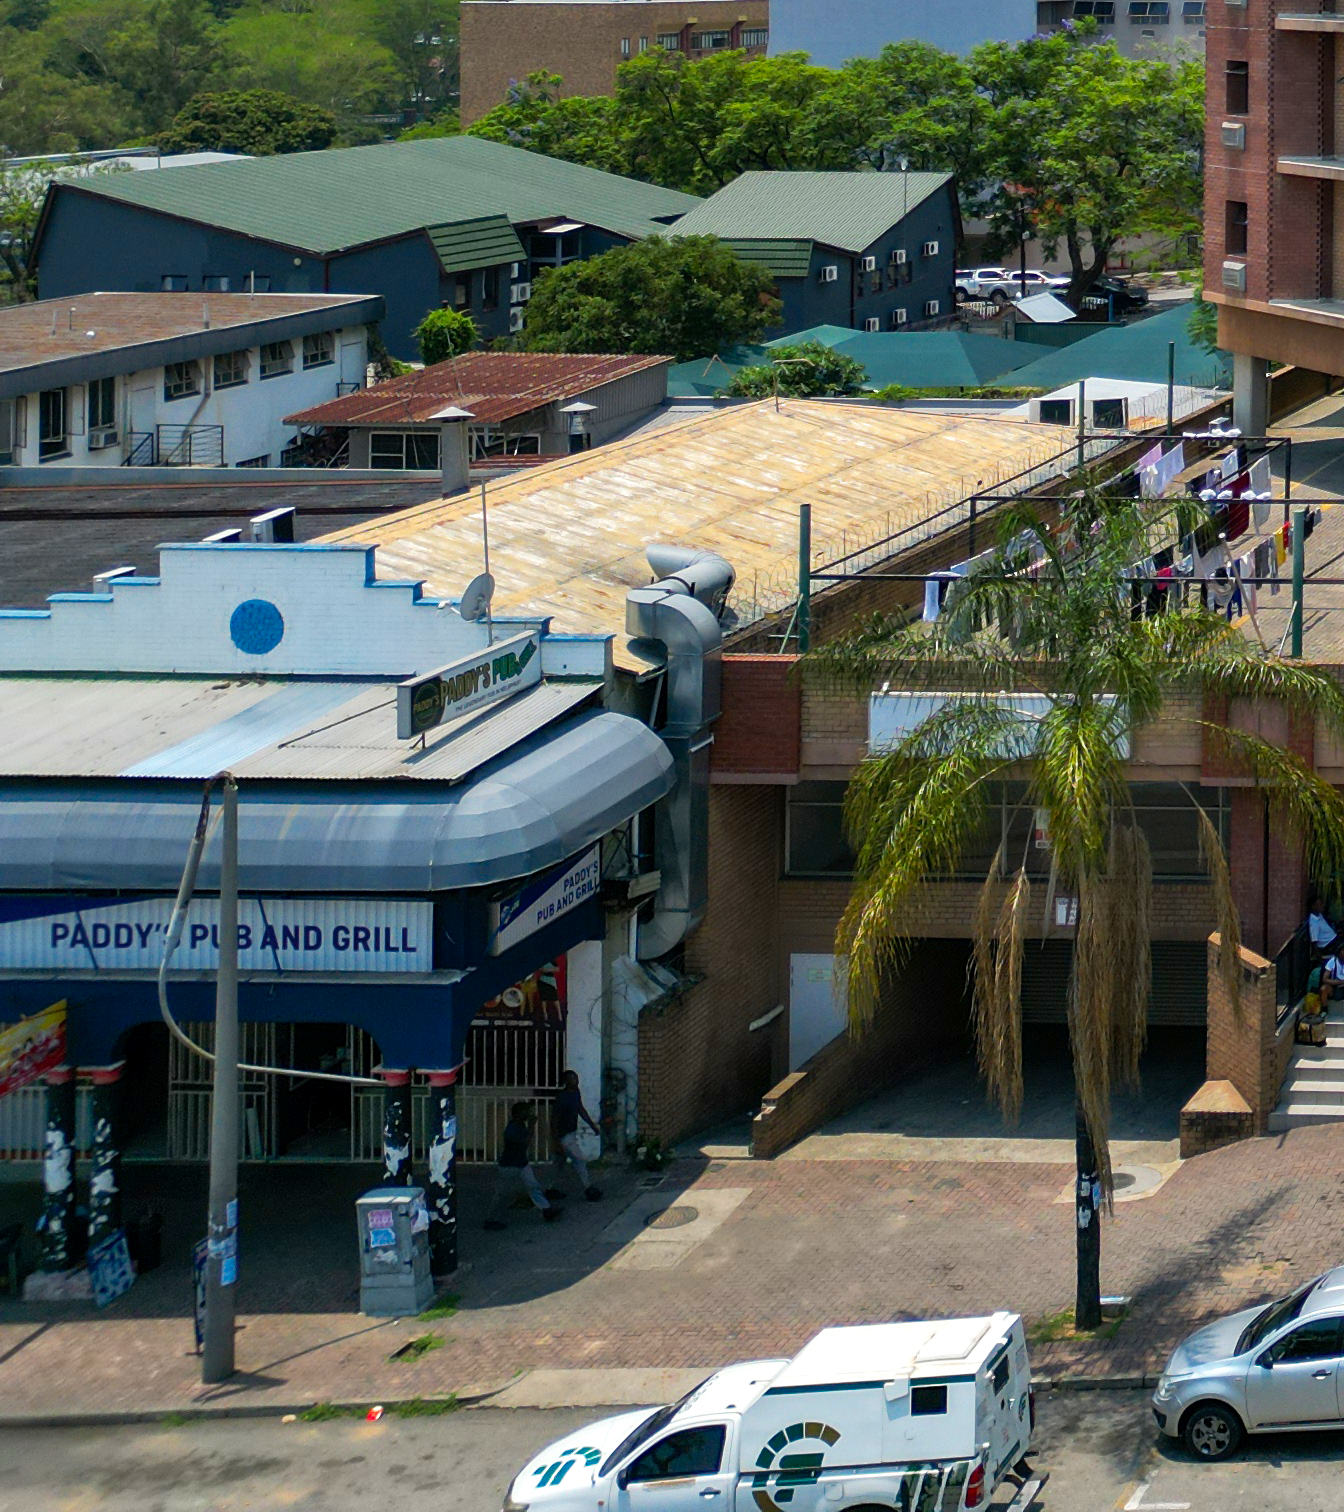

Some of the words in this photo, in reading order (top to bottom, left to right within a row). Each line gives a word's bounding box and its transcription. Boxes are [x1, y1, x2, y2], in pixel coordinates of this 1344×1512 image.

[440, 662, 491, 707] PADDY'S
[492, 652, 516, 686] PUB
[564, 861, 598, 892] PADDY'S
[537, 903, 555, 924] PUB
[557, 892, 574, 912] AND
[576, 876, 600, 899] GRILL
[260, 924, 323, 951] AND
[332, 925, 417, 953] GRILL
